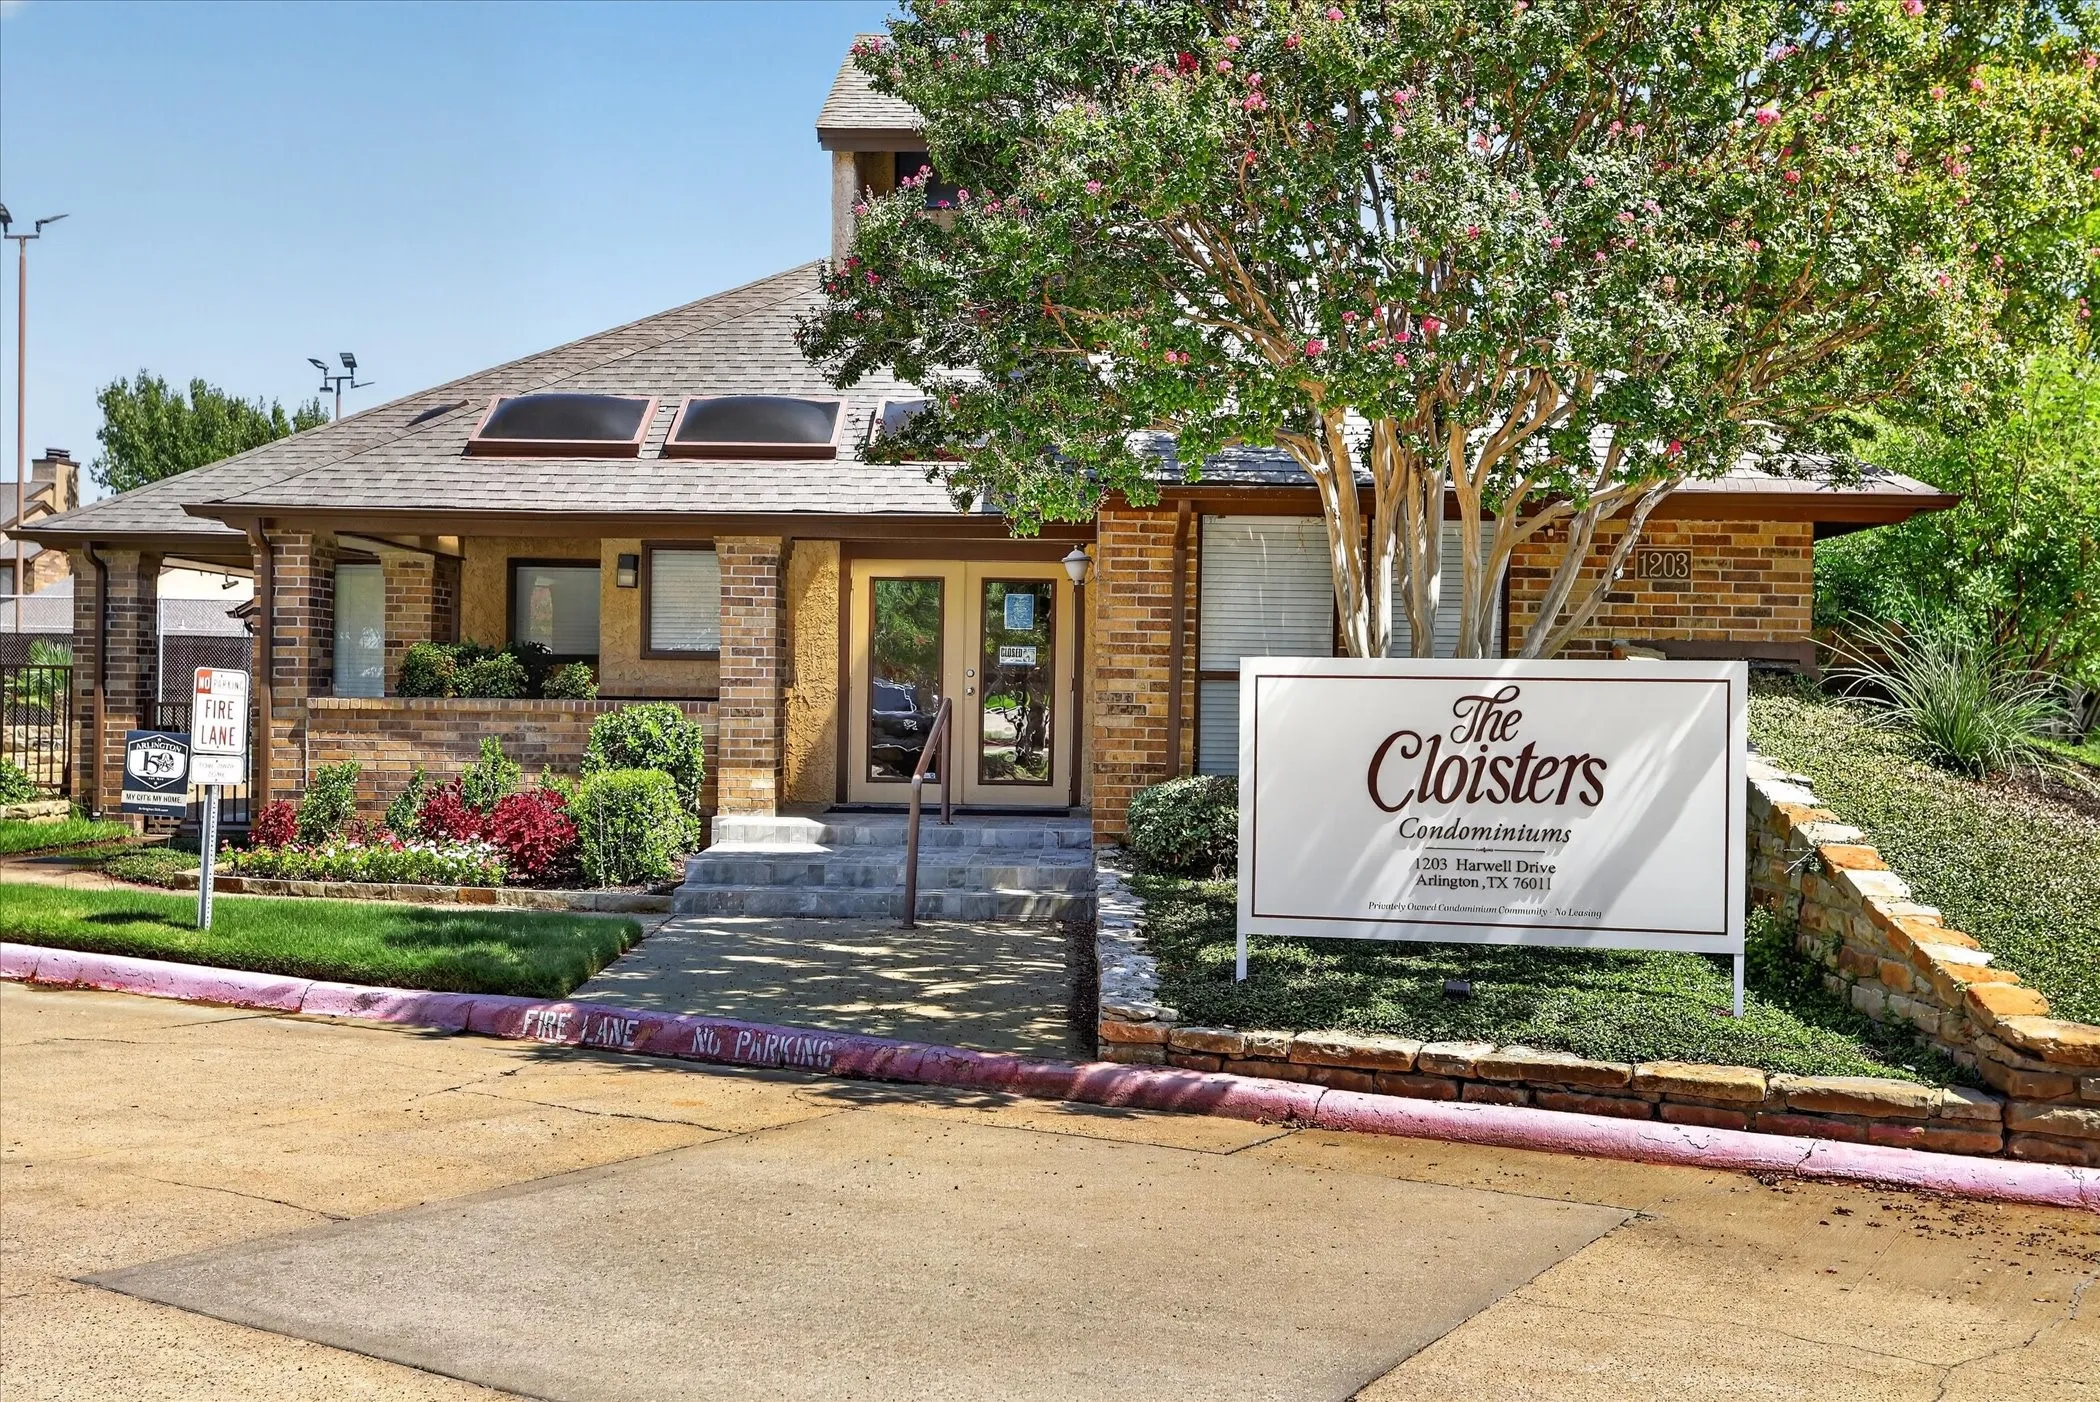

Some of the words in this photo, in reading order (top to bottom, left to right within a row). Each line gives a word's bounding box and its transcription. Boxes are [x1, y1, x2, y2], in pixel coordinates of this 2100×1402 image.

[1639, 552, 1688, 577] 1203
[1000, 647, 1023, 658] CLOSED
[197, 676, 211, 690] NO
[213, 679, 244, 692] PARKING
[205, 699, 235, 720] FIRE
[1450, 685, 1523, 744] The
[201, 725, 236, 746] LANE
[135, 741, 182, 753] ARLINGTON
[1367, 730, 1608, 813] Cloisters
[1399, 816, 1572, 843] Condominiums
[1415, 857, 1448, 871] 1203
[1455, 858, 1512, 873] Harwell
[1515, 860, 1556, 874] Drive
[1415, 874, 1479, 890] Arlington
[1513, 877, 1552, 891] 76011
[1368, 901, 1405, 912] Privately
[1407, 902, 1437, 912] Owned
[1438, 903, 1497, 915] Condominium
[1498, 906, 1548, 918] Community
[1554, 907, 1567, 917] No
[1568, 908, 1602, 920] Leasing
[521, 1009, 572, 1040] FIRE
[581, 1014, 640, 1047] LANE
[692, 1026, 722, 1056] NO
[734, 1030, 834, 1067] PARKING
